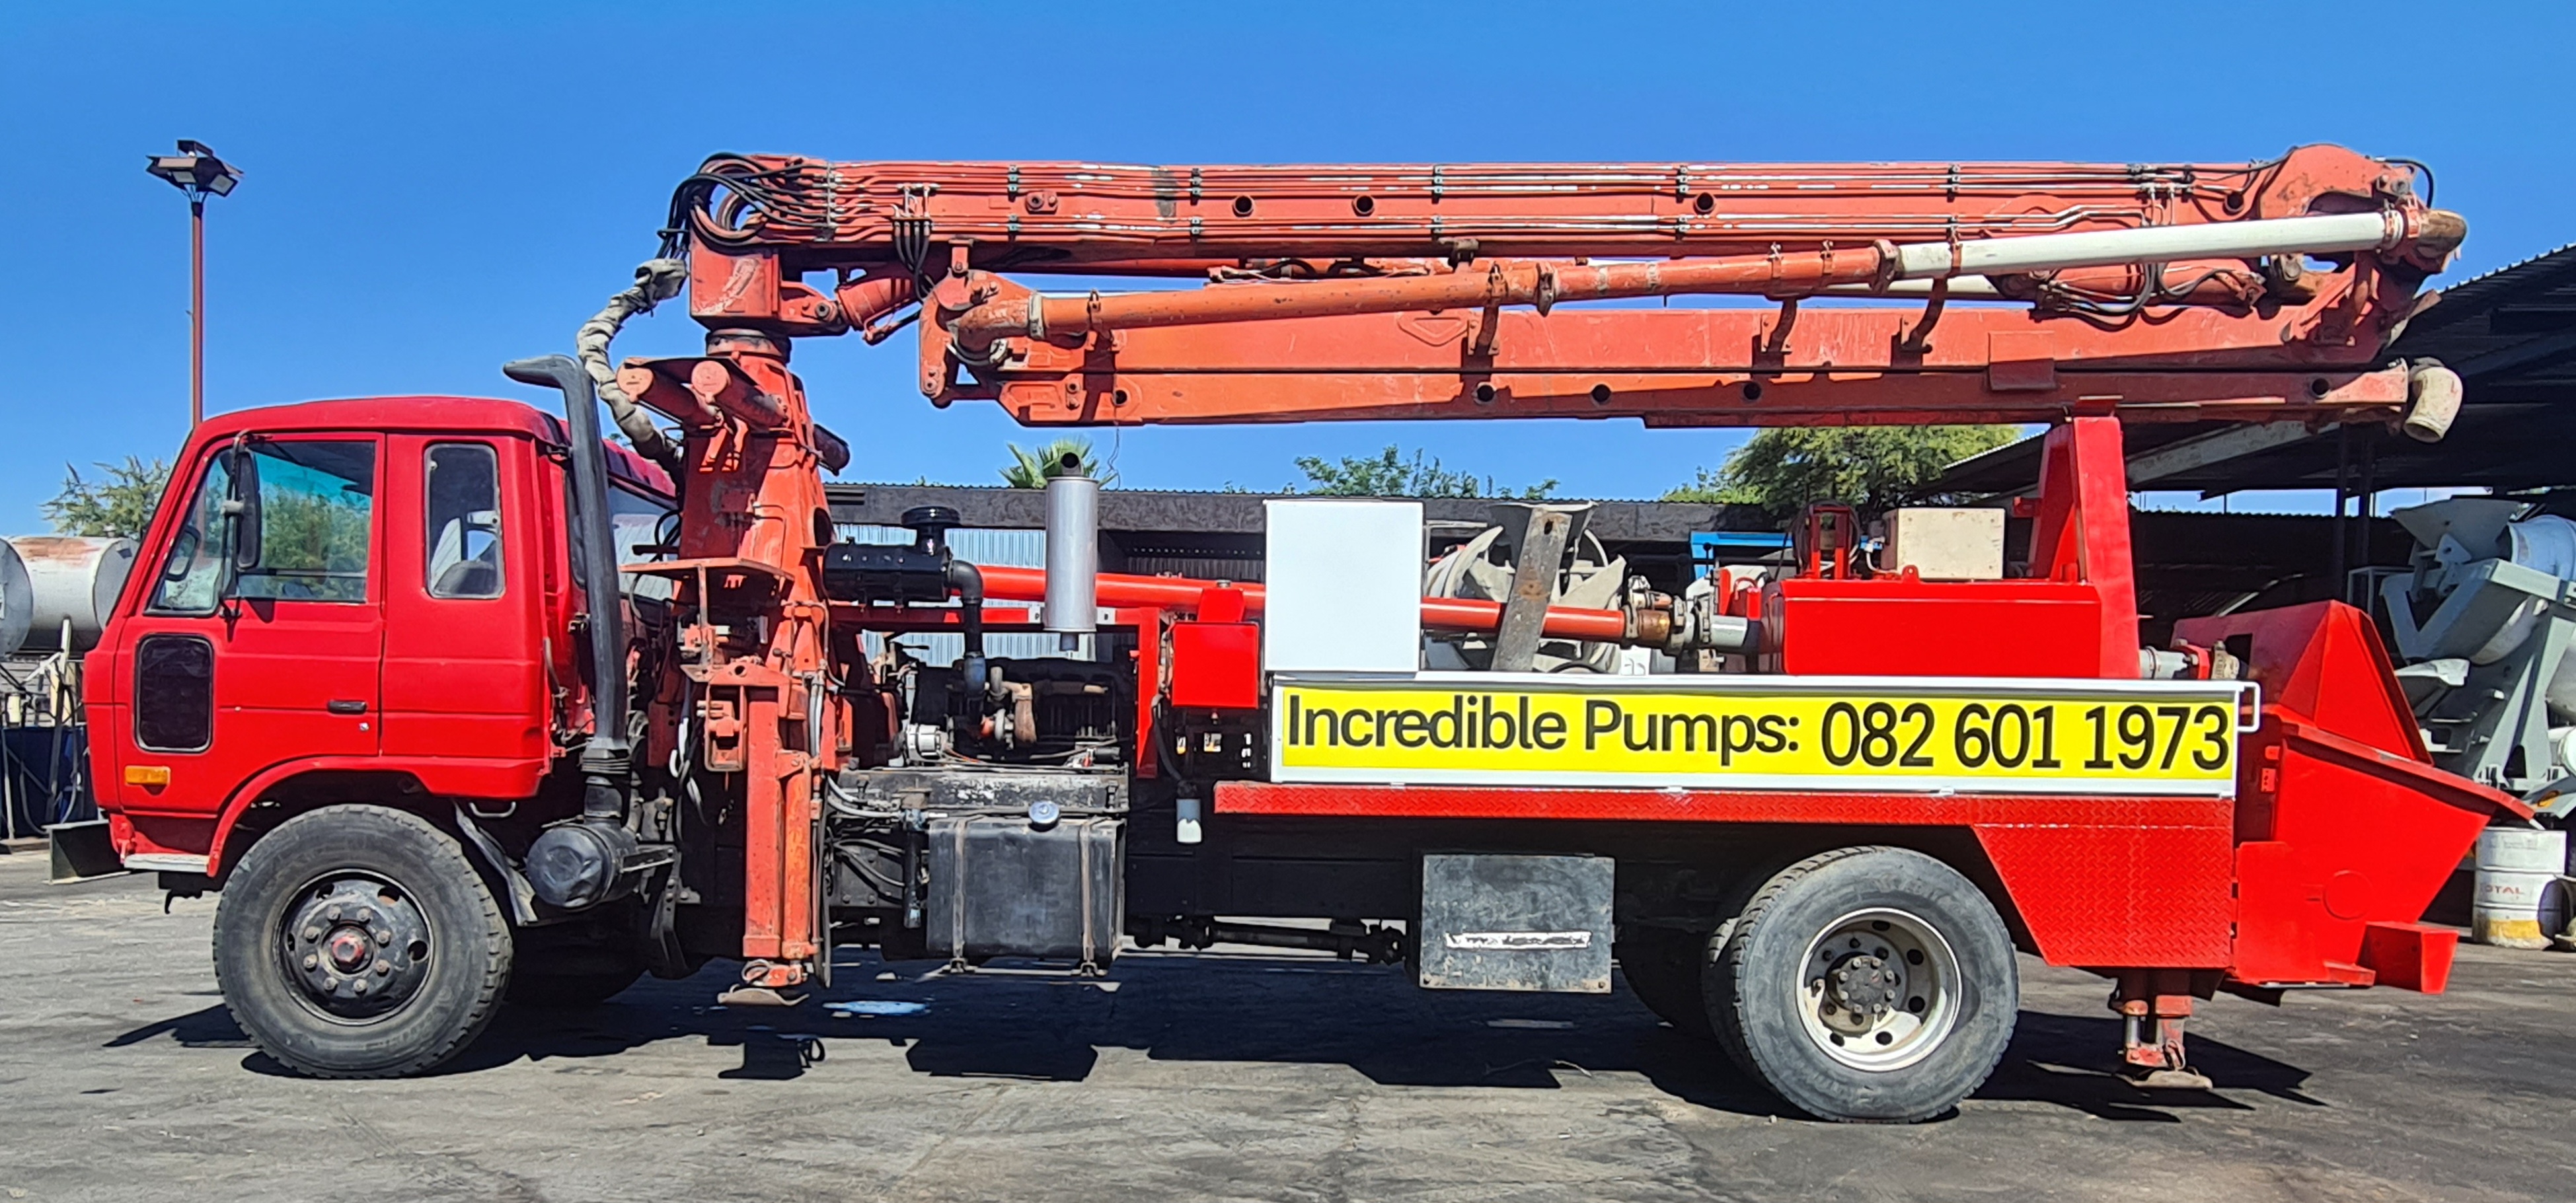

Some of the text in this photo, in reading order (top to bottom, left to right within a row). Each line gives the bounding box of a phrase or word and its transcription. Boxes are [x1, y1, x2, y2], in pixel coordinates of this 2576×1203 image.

[1290, 695, 2228, 770] Incredible Pumps: 082 601 1973
[2480, 883, 2525, 895] OTAL
